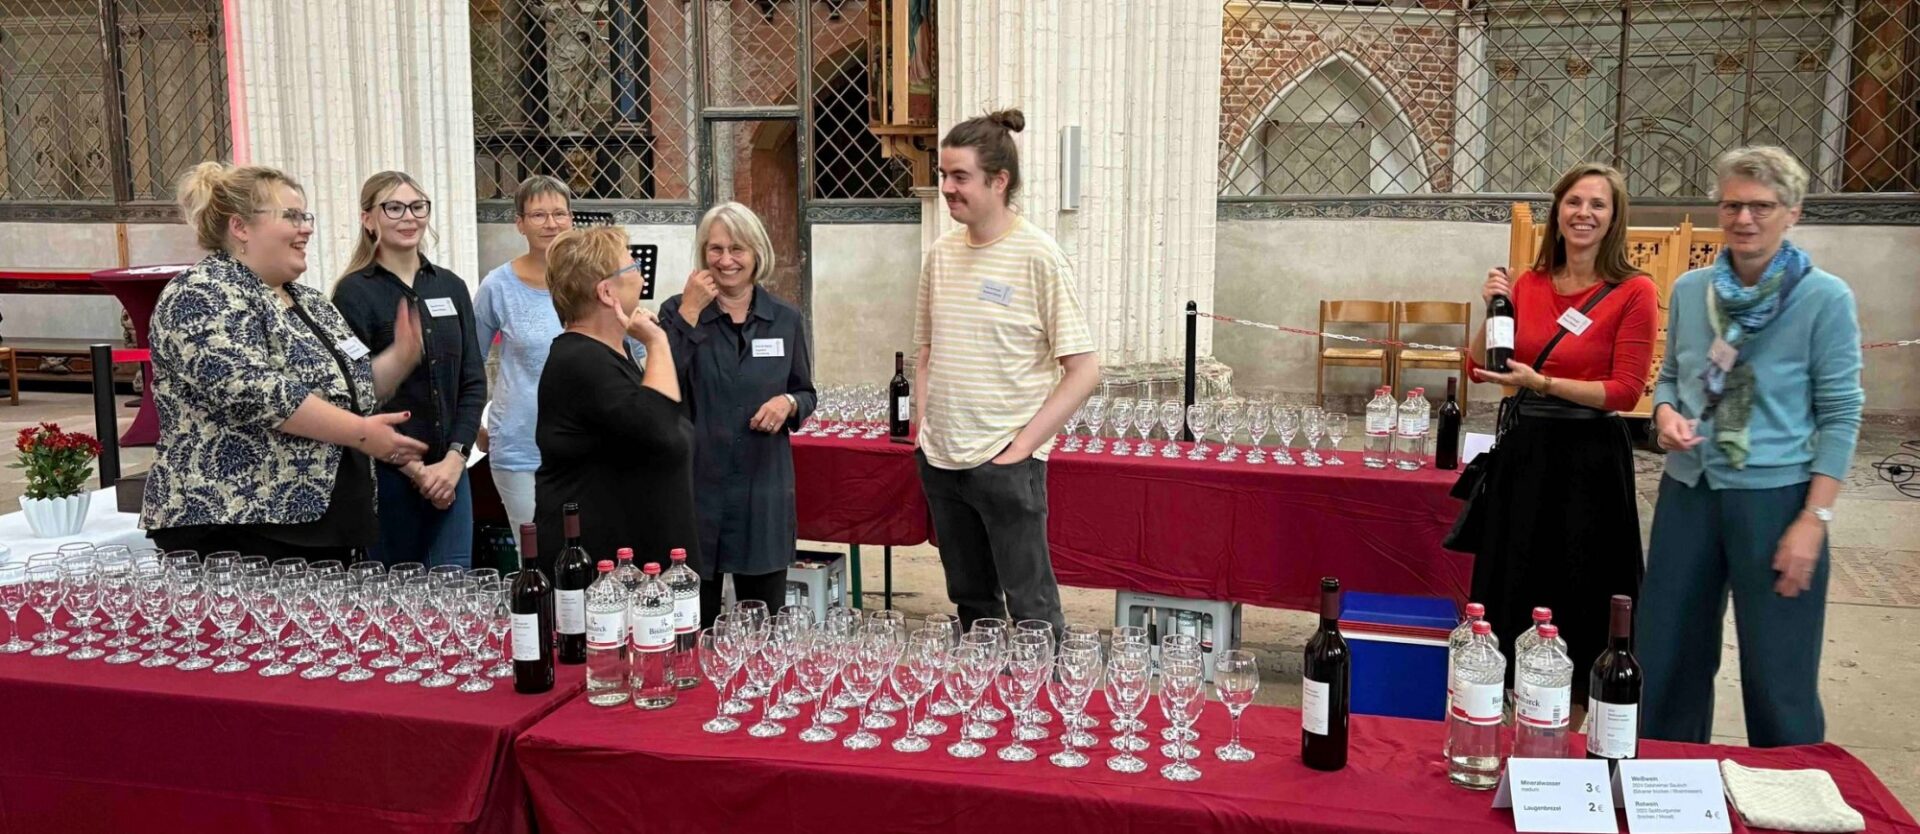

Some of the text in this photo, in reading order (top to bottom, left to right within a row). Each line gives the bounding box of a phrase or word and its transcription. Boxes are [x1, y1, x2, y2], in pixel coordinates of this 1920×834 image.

[1585, 782, 1601, 793] 3 €
[1588, 802, 1604, 812] 2 €
[1705, 809, 1720, 819] 4 €
